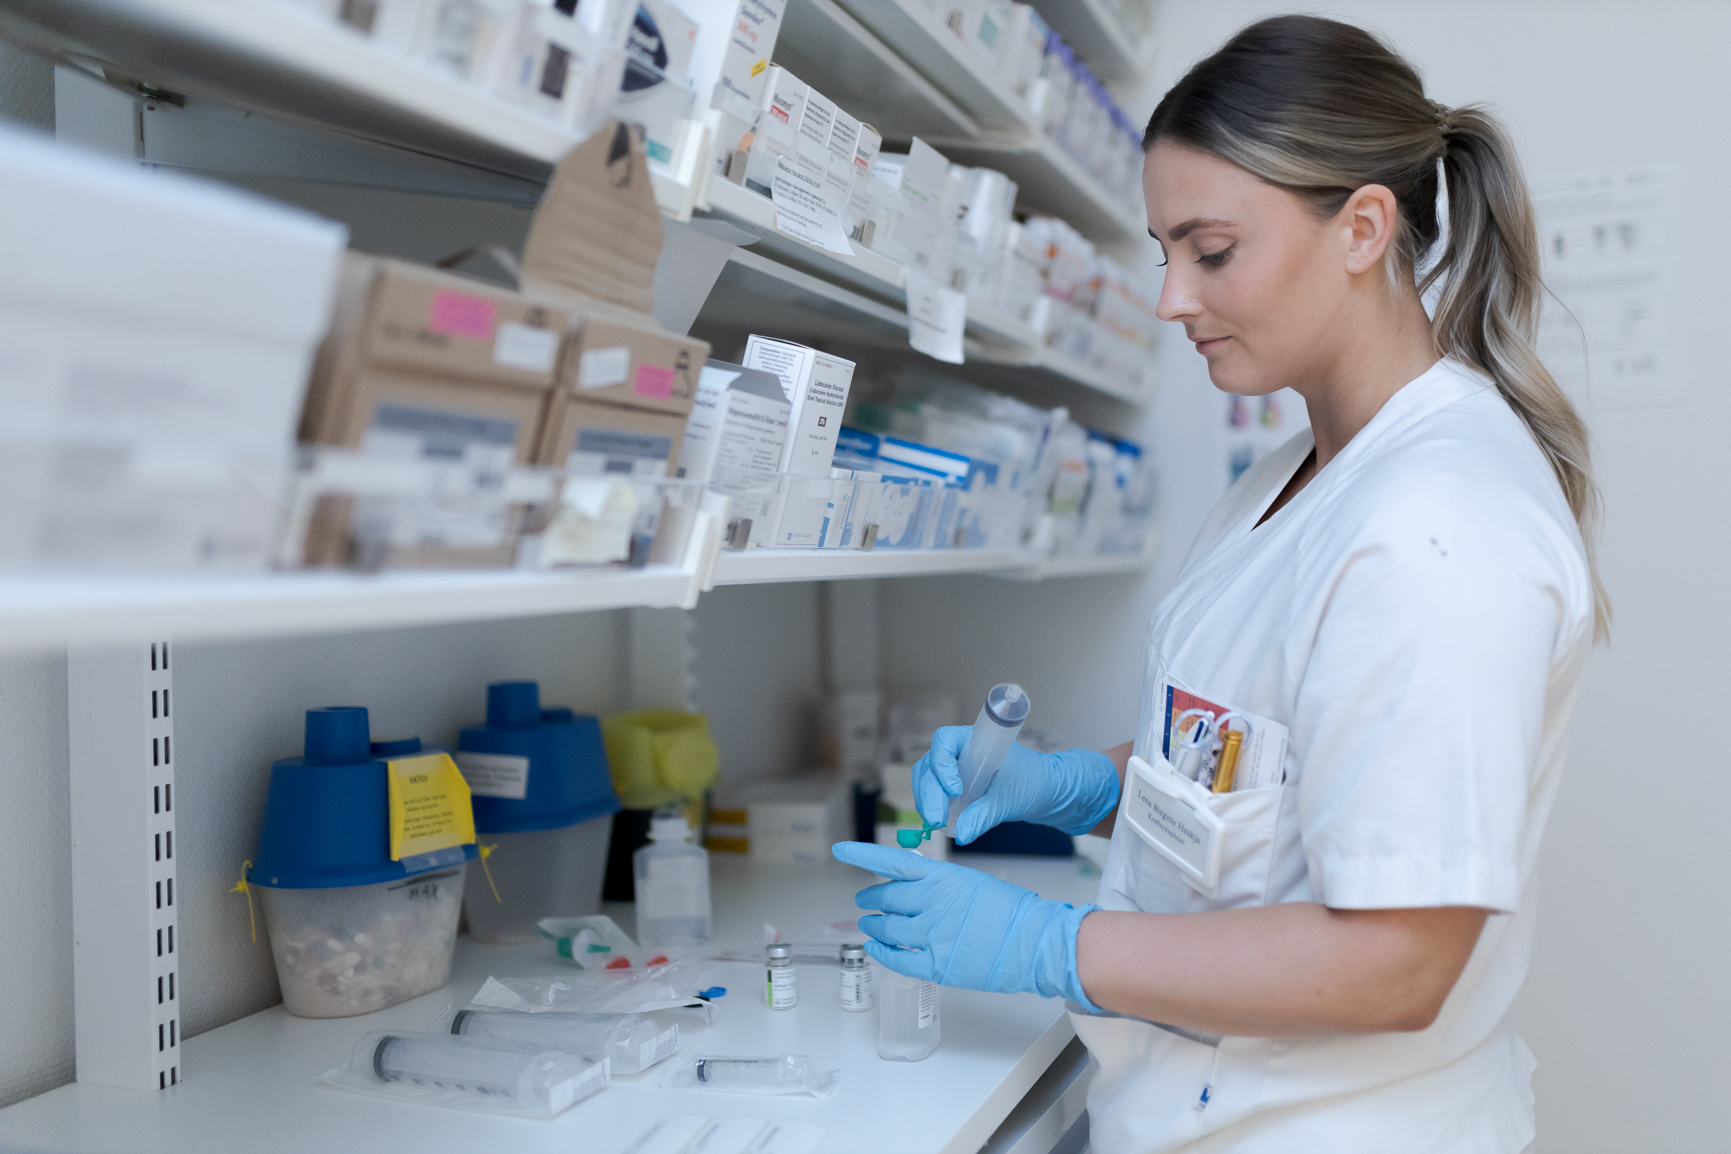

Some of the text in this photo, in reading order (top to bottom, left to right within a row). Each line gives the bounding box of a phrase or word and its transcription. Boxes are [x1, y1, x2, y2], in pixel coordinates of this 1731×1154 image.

[814, 380, 832, 389] Lidocaine
[1138, 790, 1152, 807] Lena
[1153, 803, 1176, 827] Birgitte
